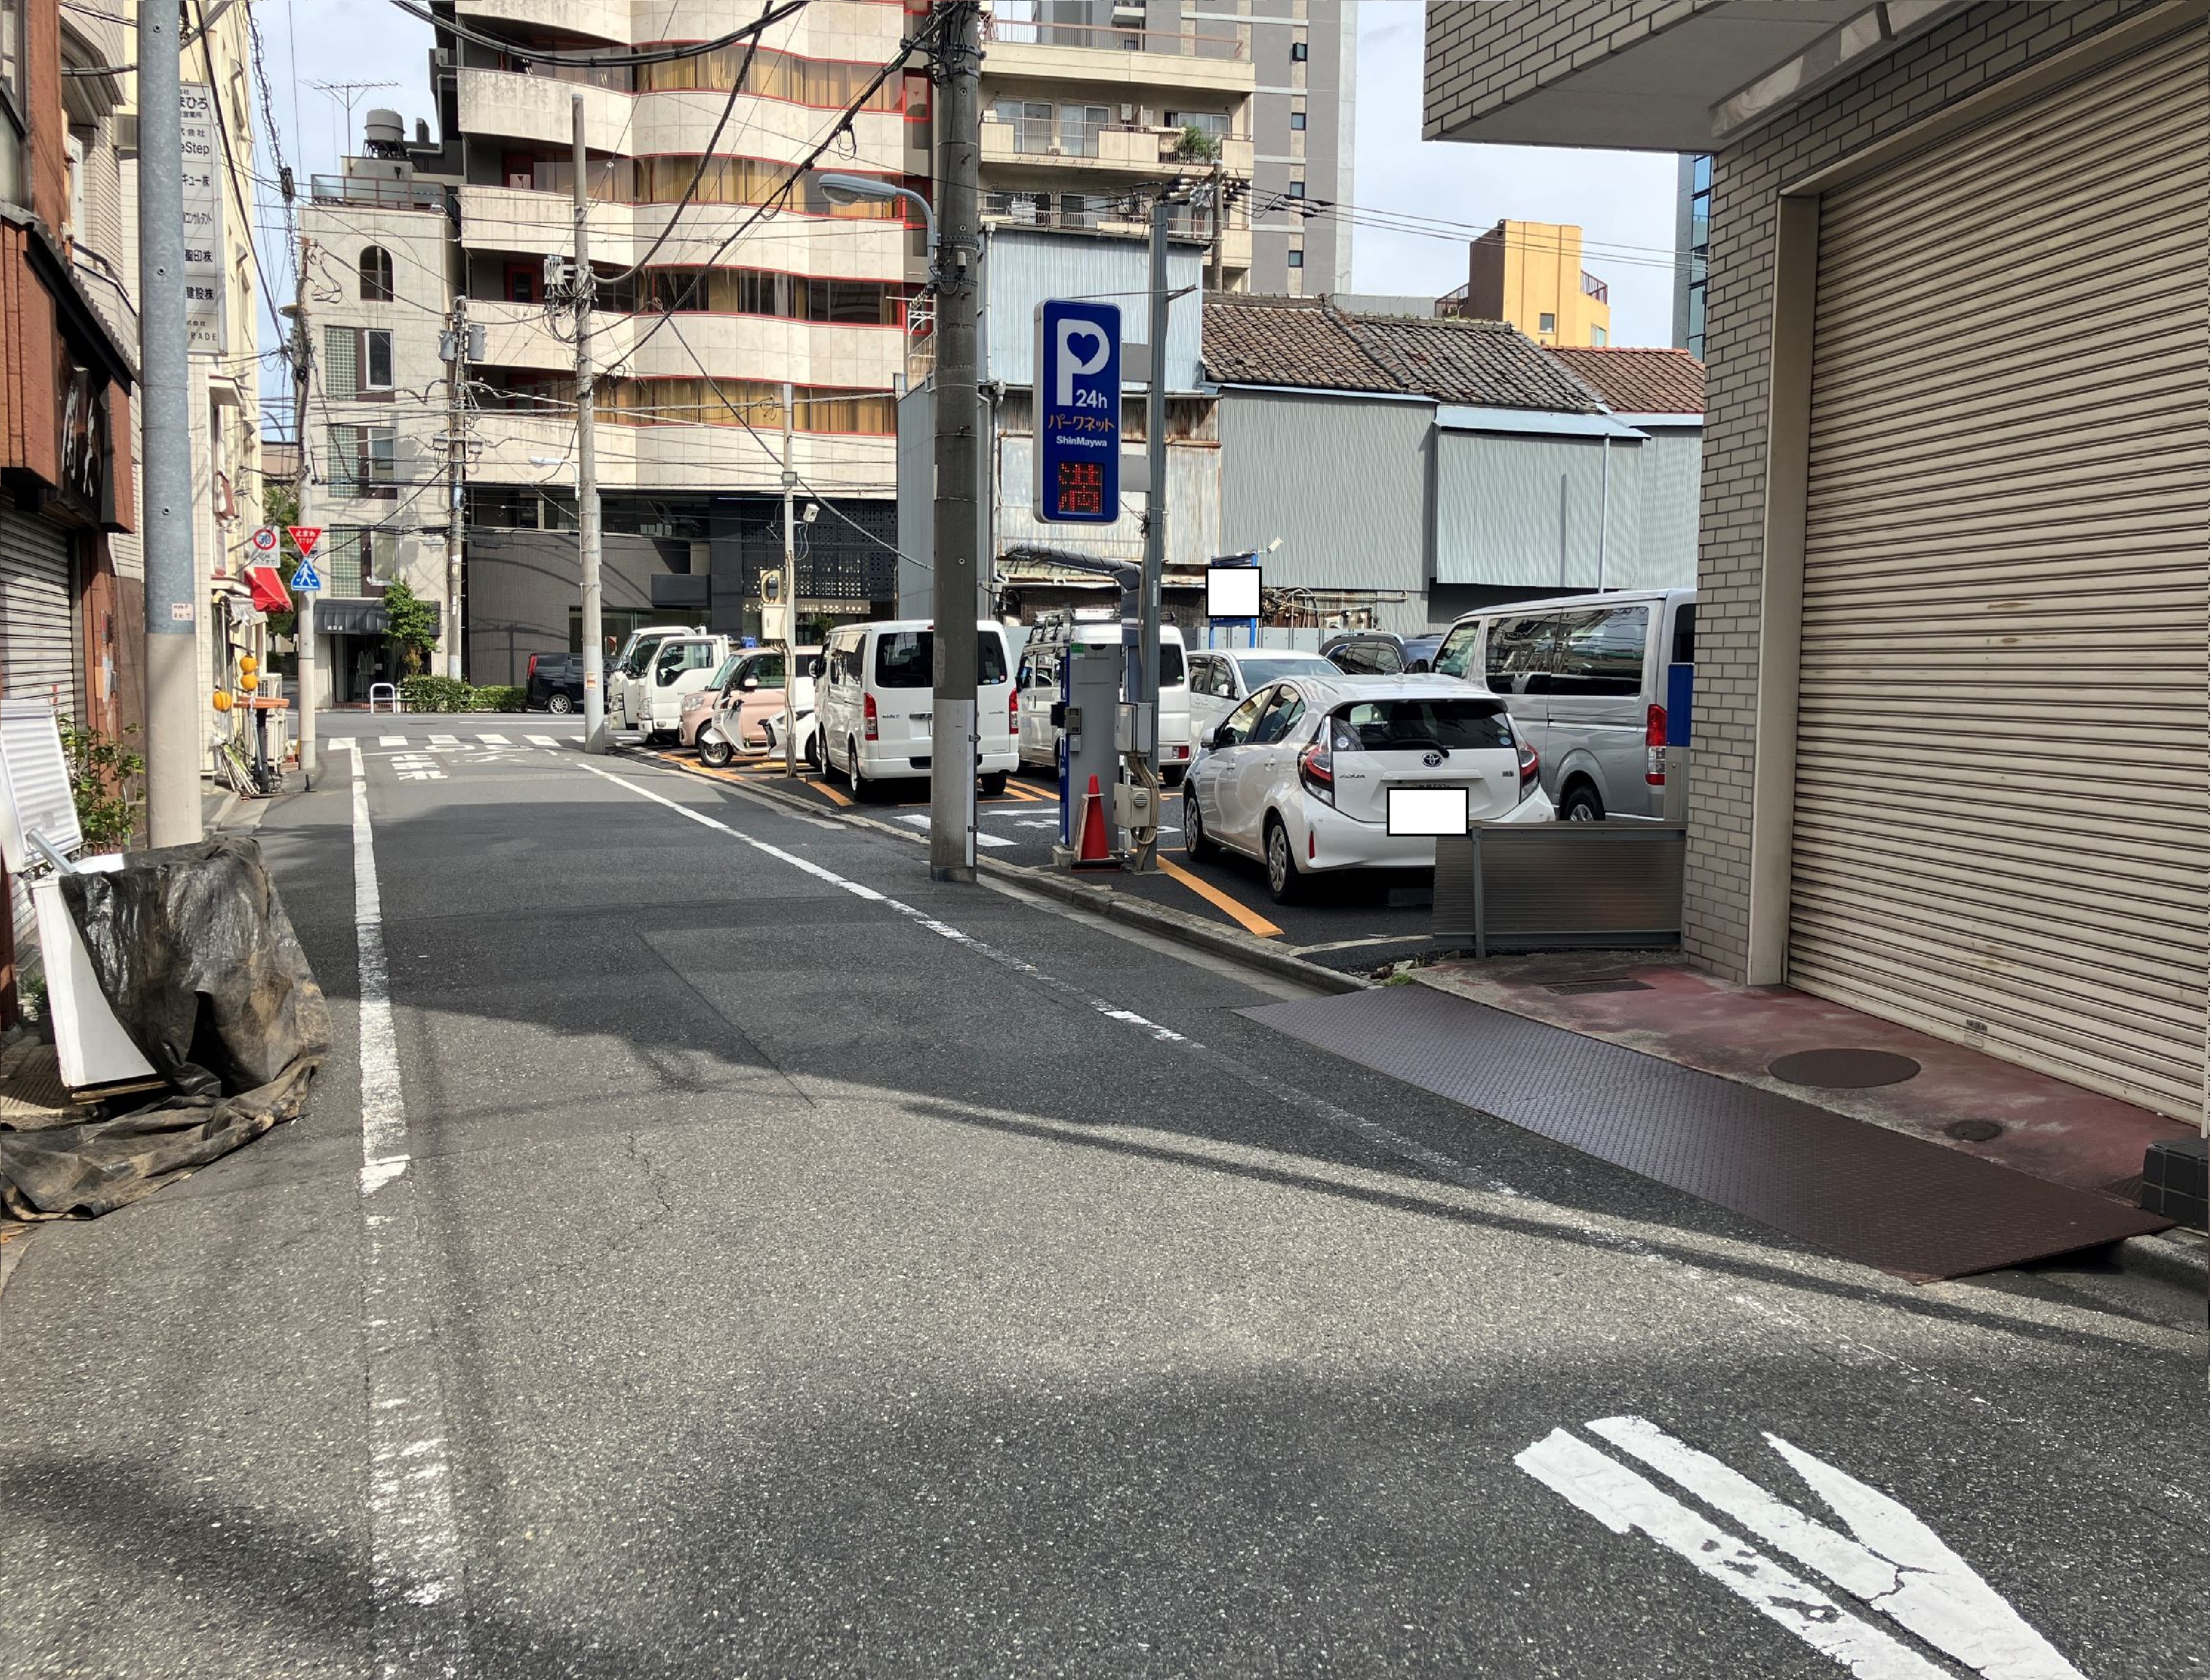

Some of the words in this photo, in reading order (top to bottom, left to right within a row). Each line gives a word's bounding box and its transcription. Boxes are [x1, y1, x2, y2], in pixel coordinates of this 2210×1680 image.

[1057, 318, 1110, 406] P
[1075, 389, 1107, 409] 24h
[1048, 414, 1115, 432] パークネット
[1056, 436, 1107, 448] ShinMaywa
